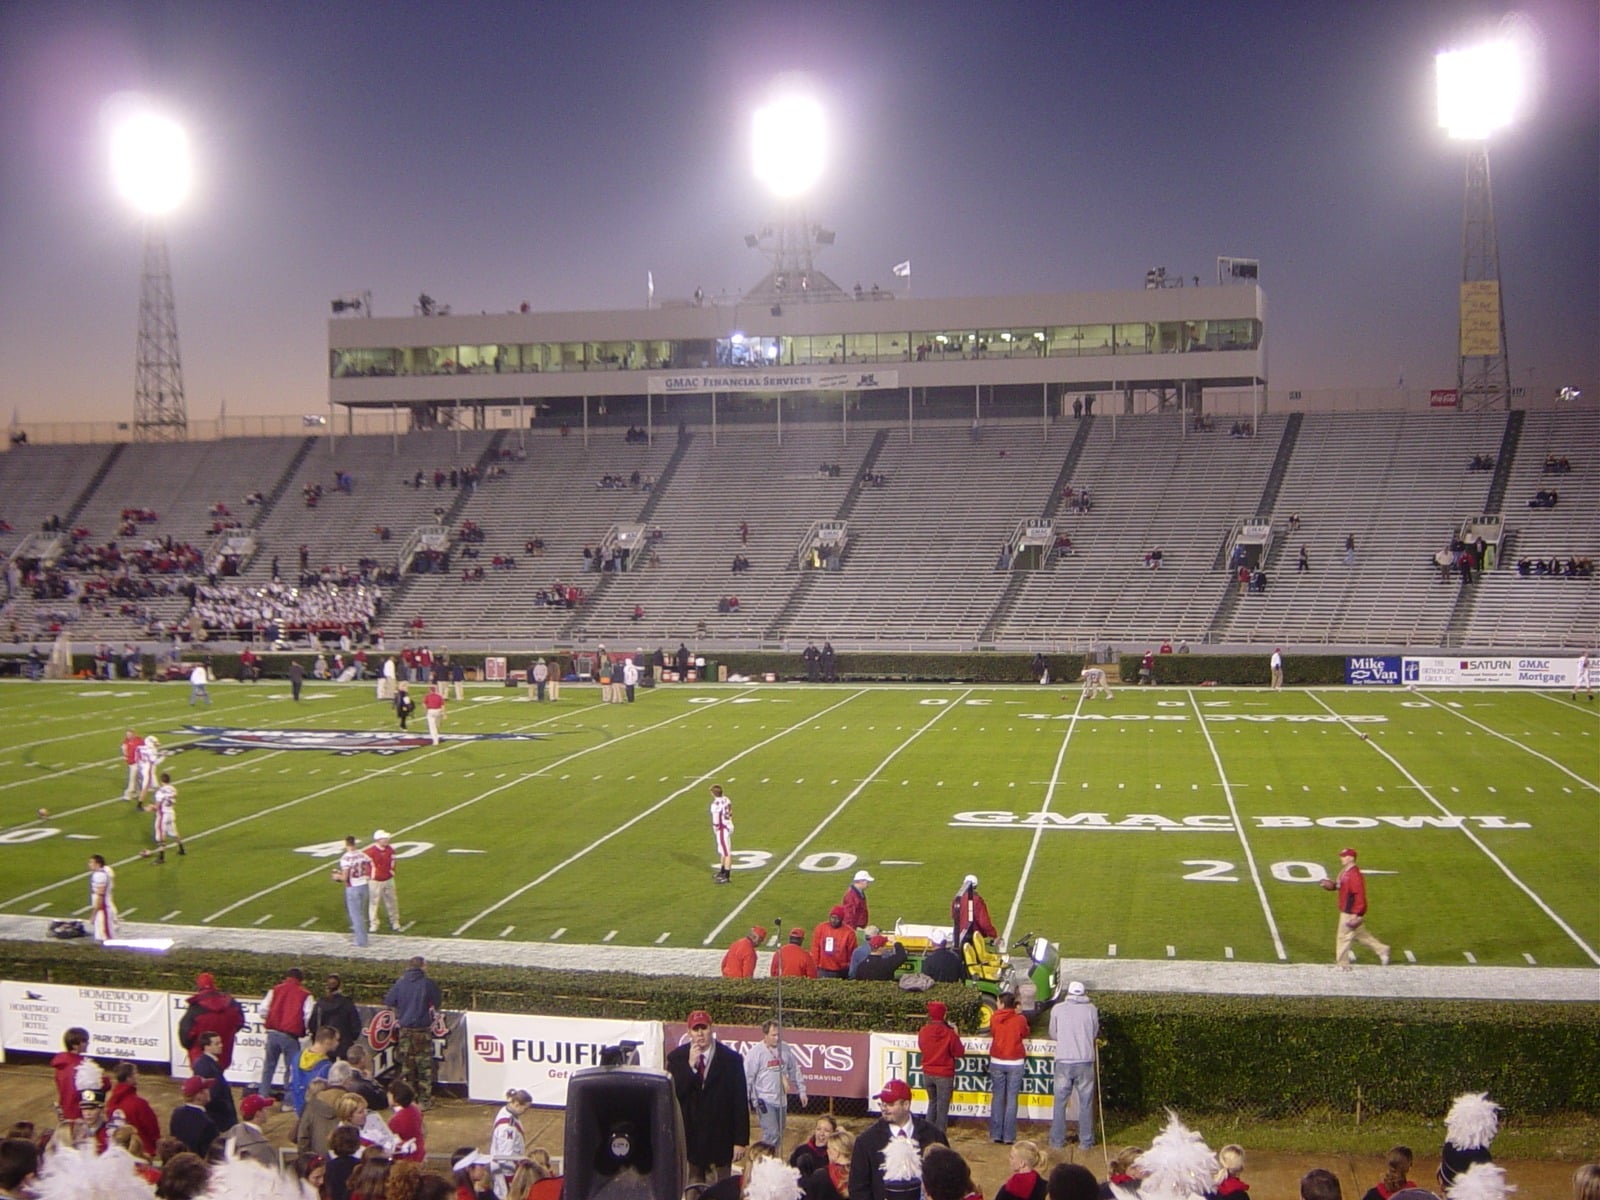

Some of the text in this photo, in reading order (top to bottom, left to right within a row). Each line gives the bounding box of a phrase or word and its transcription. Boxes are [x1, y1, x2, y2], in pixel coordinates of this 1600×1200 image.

[665, 378, 699, 388] GMAC
[1351, 657, 1385, 669] Mike
[1470, 661, 1511, 669] SATURN
[1518, 659, 1550, 669] GMAC
[1371, 668, 1398, 679] Van
[1518, 672, 1566, 683] Mortgage
[951, 811, 1533, 829] GMAC BOWL
[78, 988, 150, 1003] HOMEWOOD
[9, 1003, 59, 1014] HOMEWOOD
[93, 1001, 132, 1013] SUITES
[22, 1012, 49, 1022] SUITES
[95, 1013, 131, 1024] HOTEL
[22, 1021, 49, 1030] HOTEL
[92, 1033, 160, 1048] PARK DRIVE EAST
[373, 1038, 447, 1078] LIT
[547, 1068, 569, 1079] Get
[802, 1073, 843, 1082] NGRAVING
